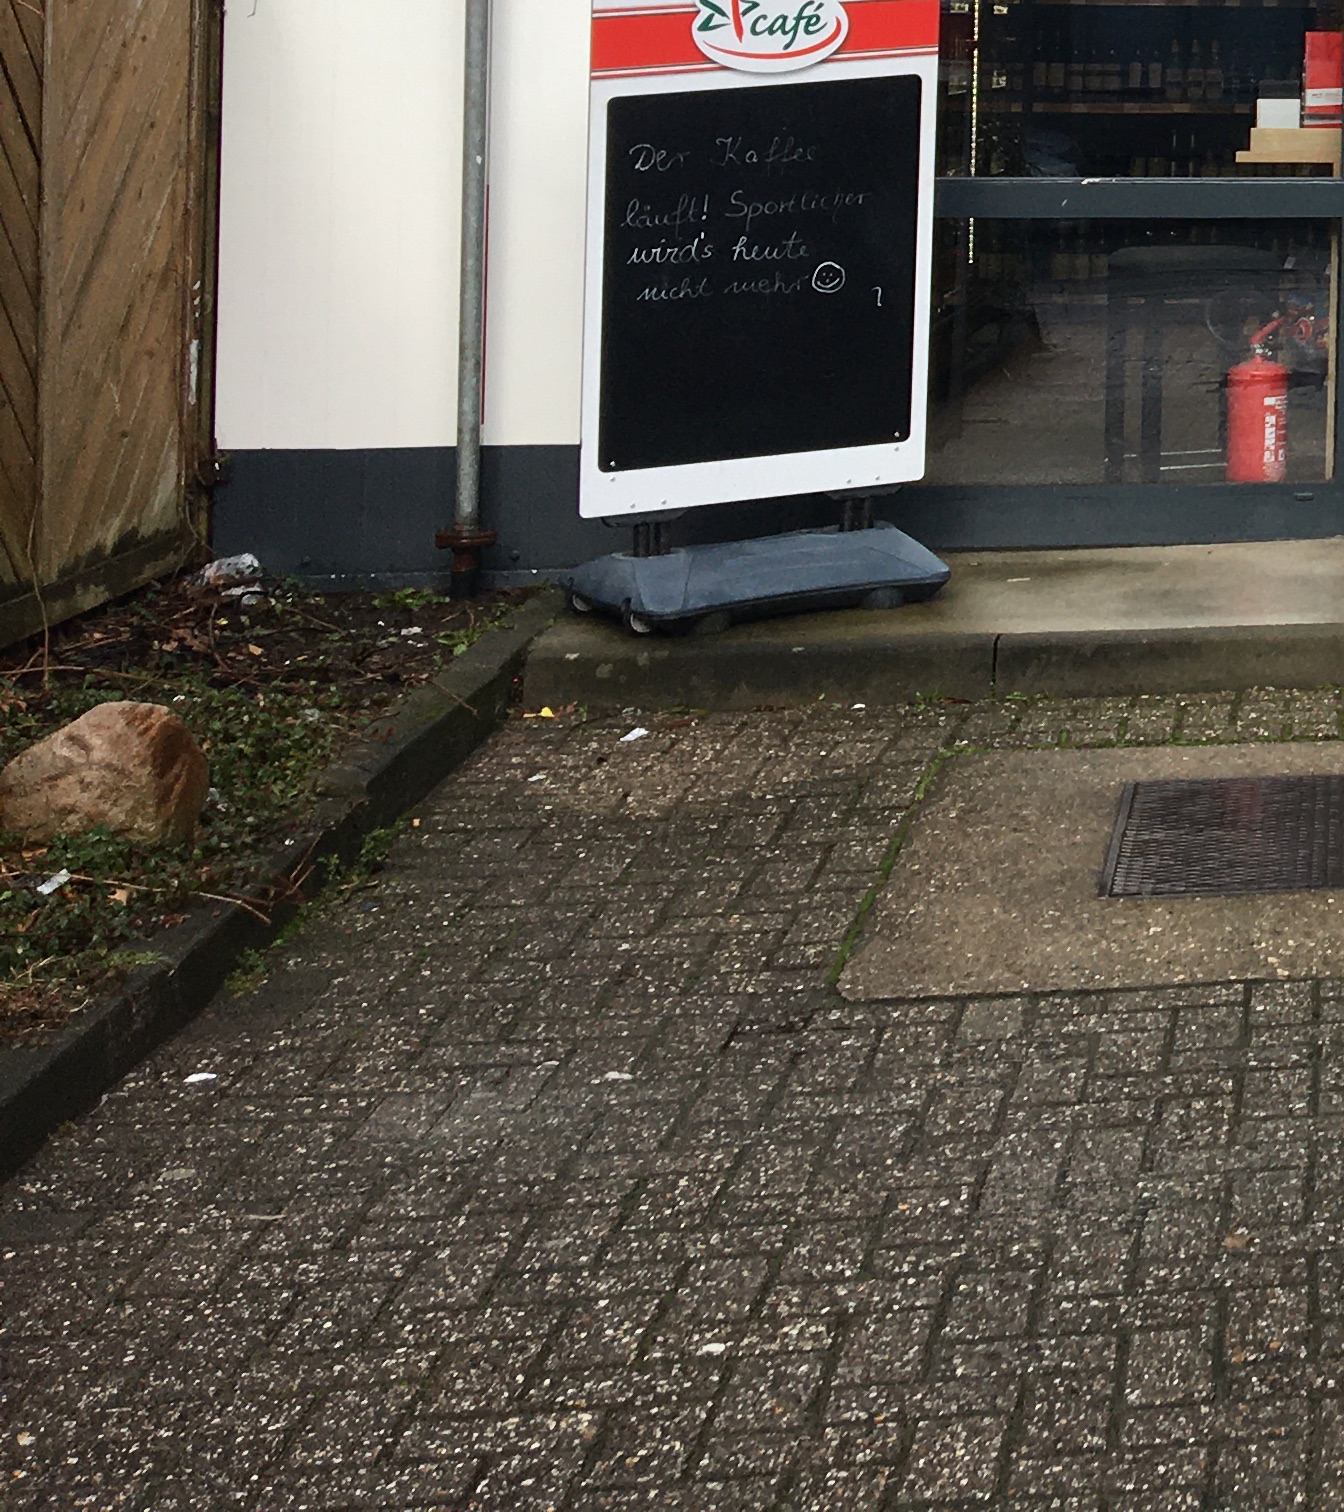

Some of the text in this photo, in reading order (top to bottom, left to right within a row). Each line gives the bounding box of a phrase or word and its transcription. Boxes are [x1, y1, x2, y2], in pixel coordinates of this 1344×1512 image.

[750, 0, 828, 51] café
[628, 136, 817, 178] Der Kaffee
[620, 189, 872, 238] läuft! Sportlicher
[626, 231, 809, 265] wird's heute
[637, 271, 809, 302] nicht mehr
